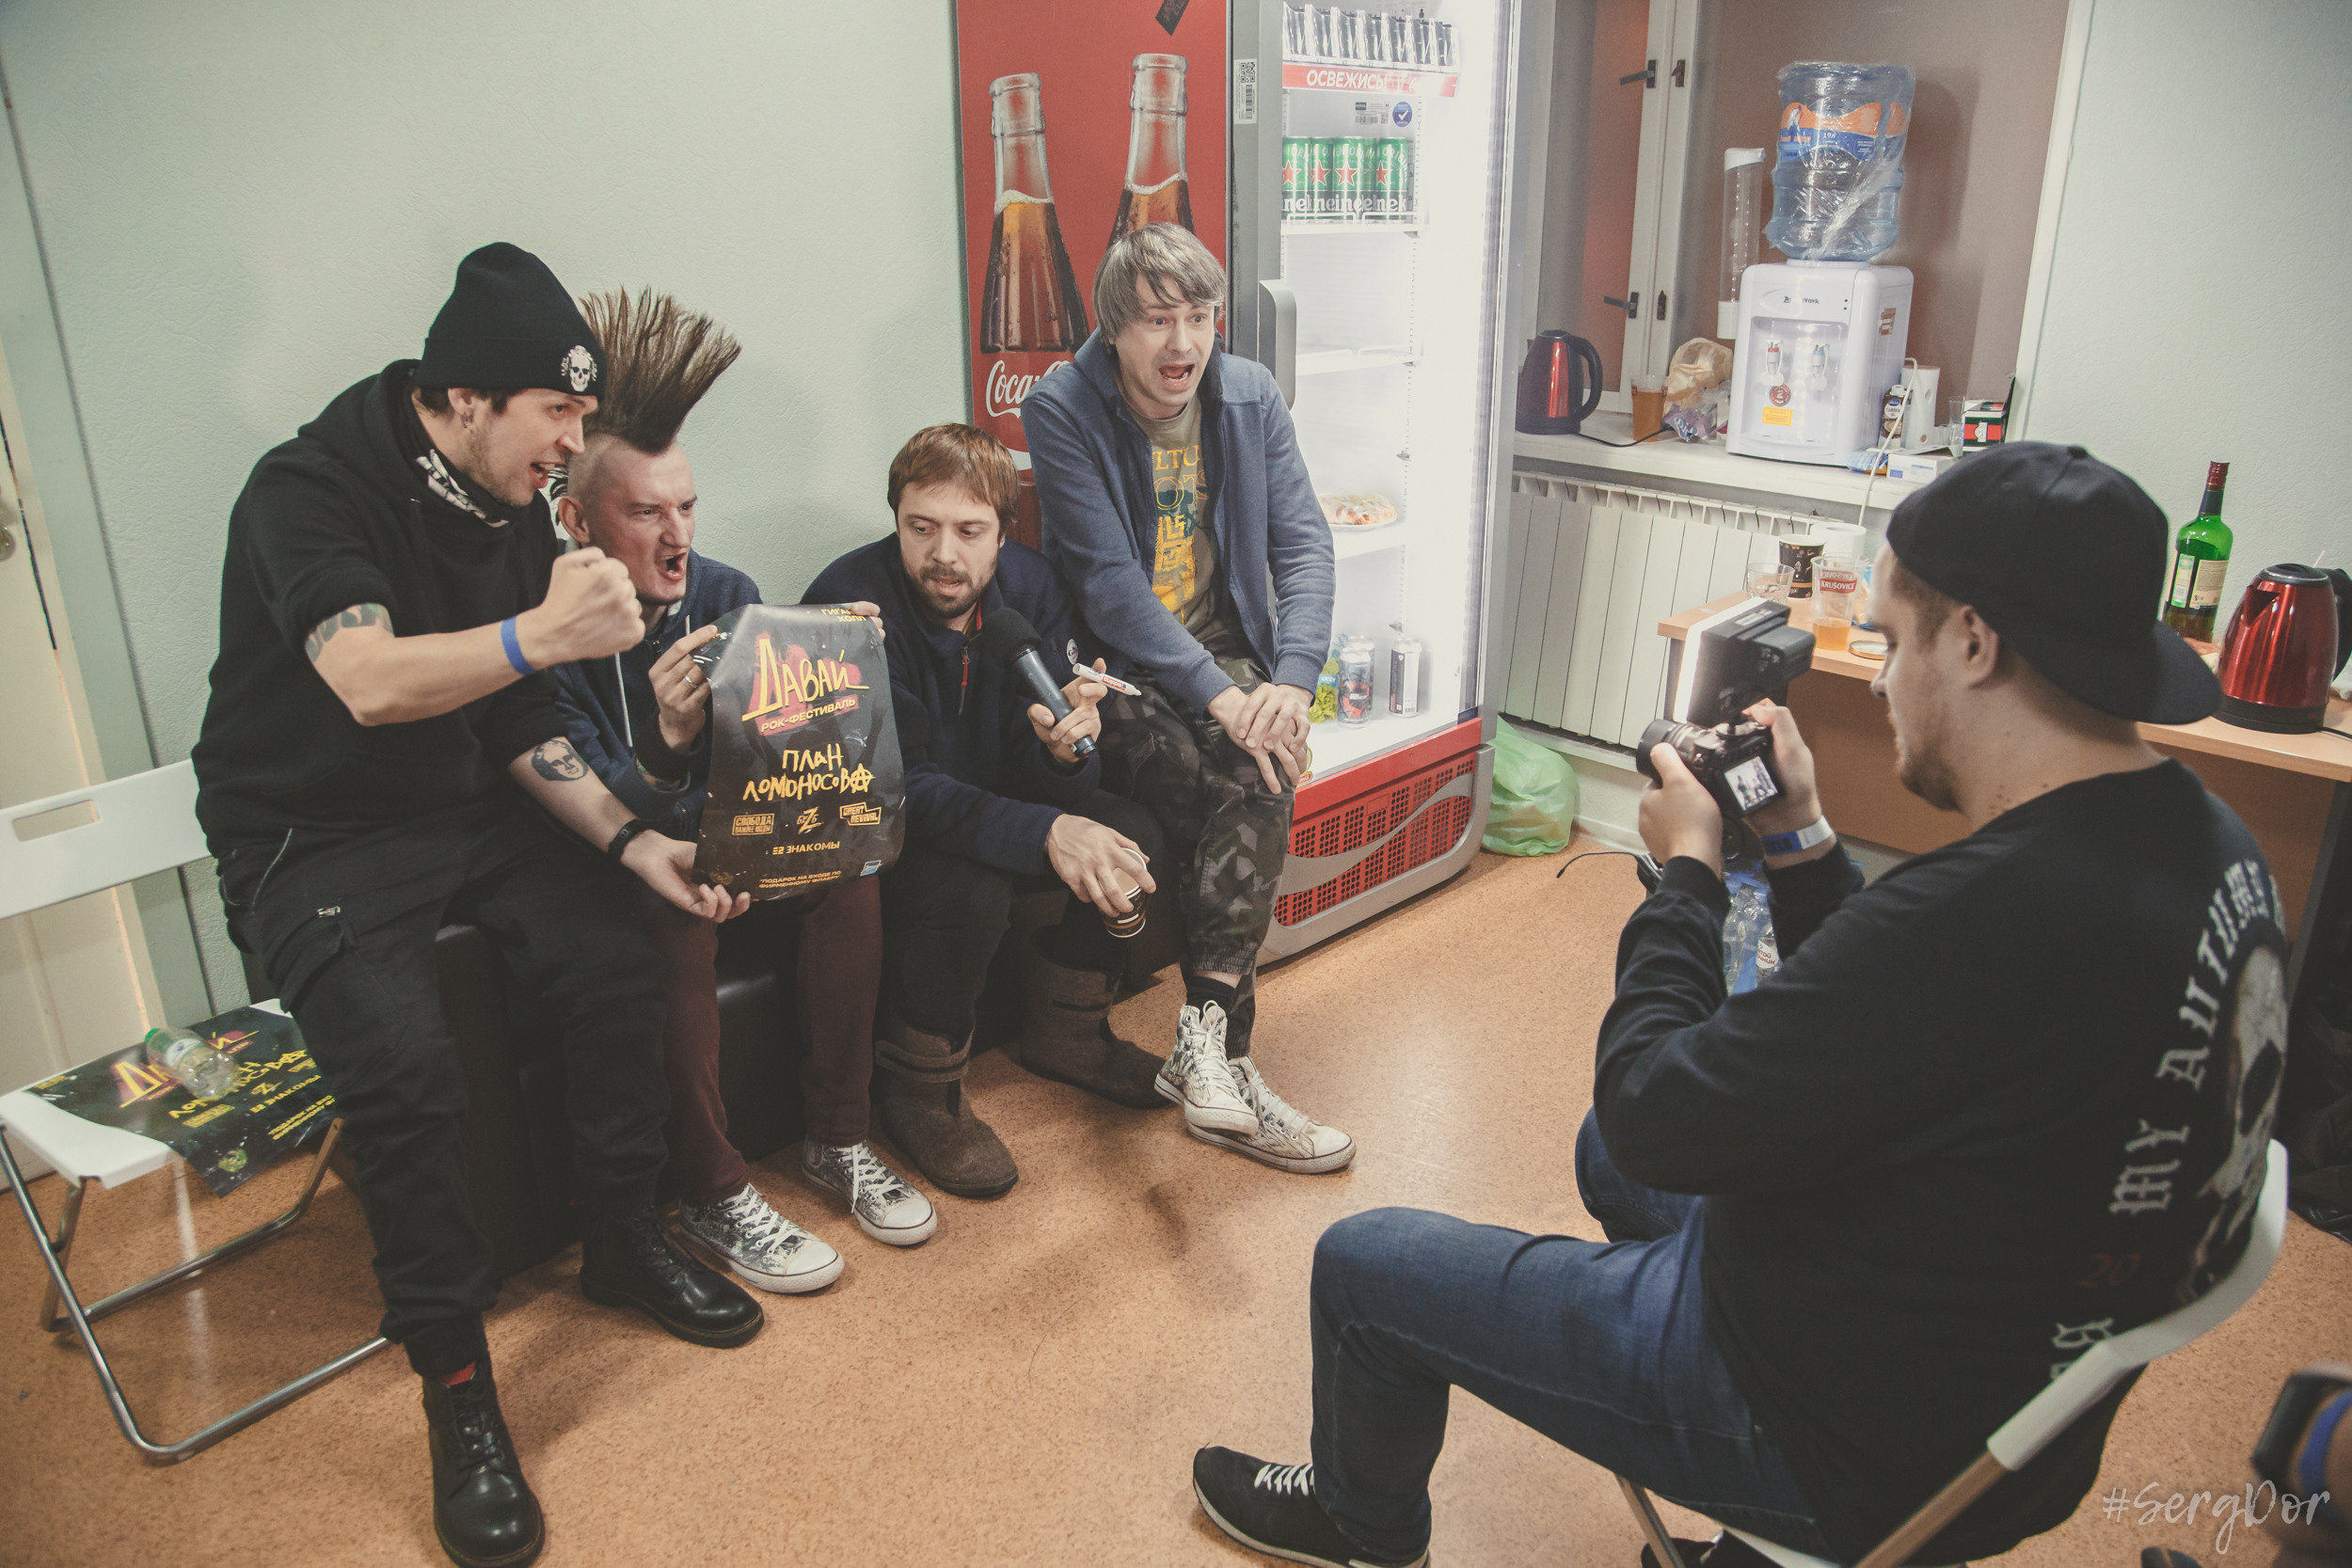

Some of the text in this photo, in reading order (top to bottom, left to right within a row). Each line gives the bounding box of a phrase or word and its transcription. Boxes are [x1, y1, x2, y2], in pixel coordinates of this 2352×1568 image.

[741, 639, 870, 721] ДАВАЙ
[761, 698, 856, 733] РОК-ФЕСТИВАЛЬ
[782, 743, 844, 772] ПЛАН
[742, 763, 877, 801] ЛОМОНОСОВА
[786, 840, 840, 854] ЗНАКОМЫ
